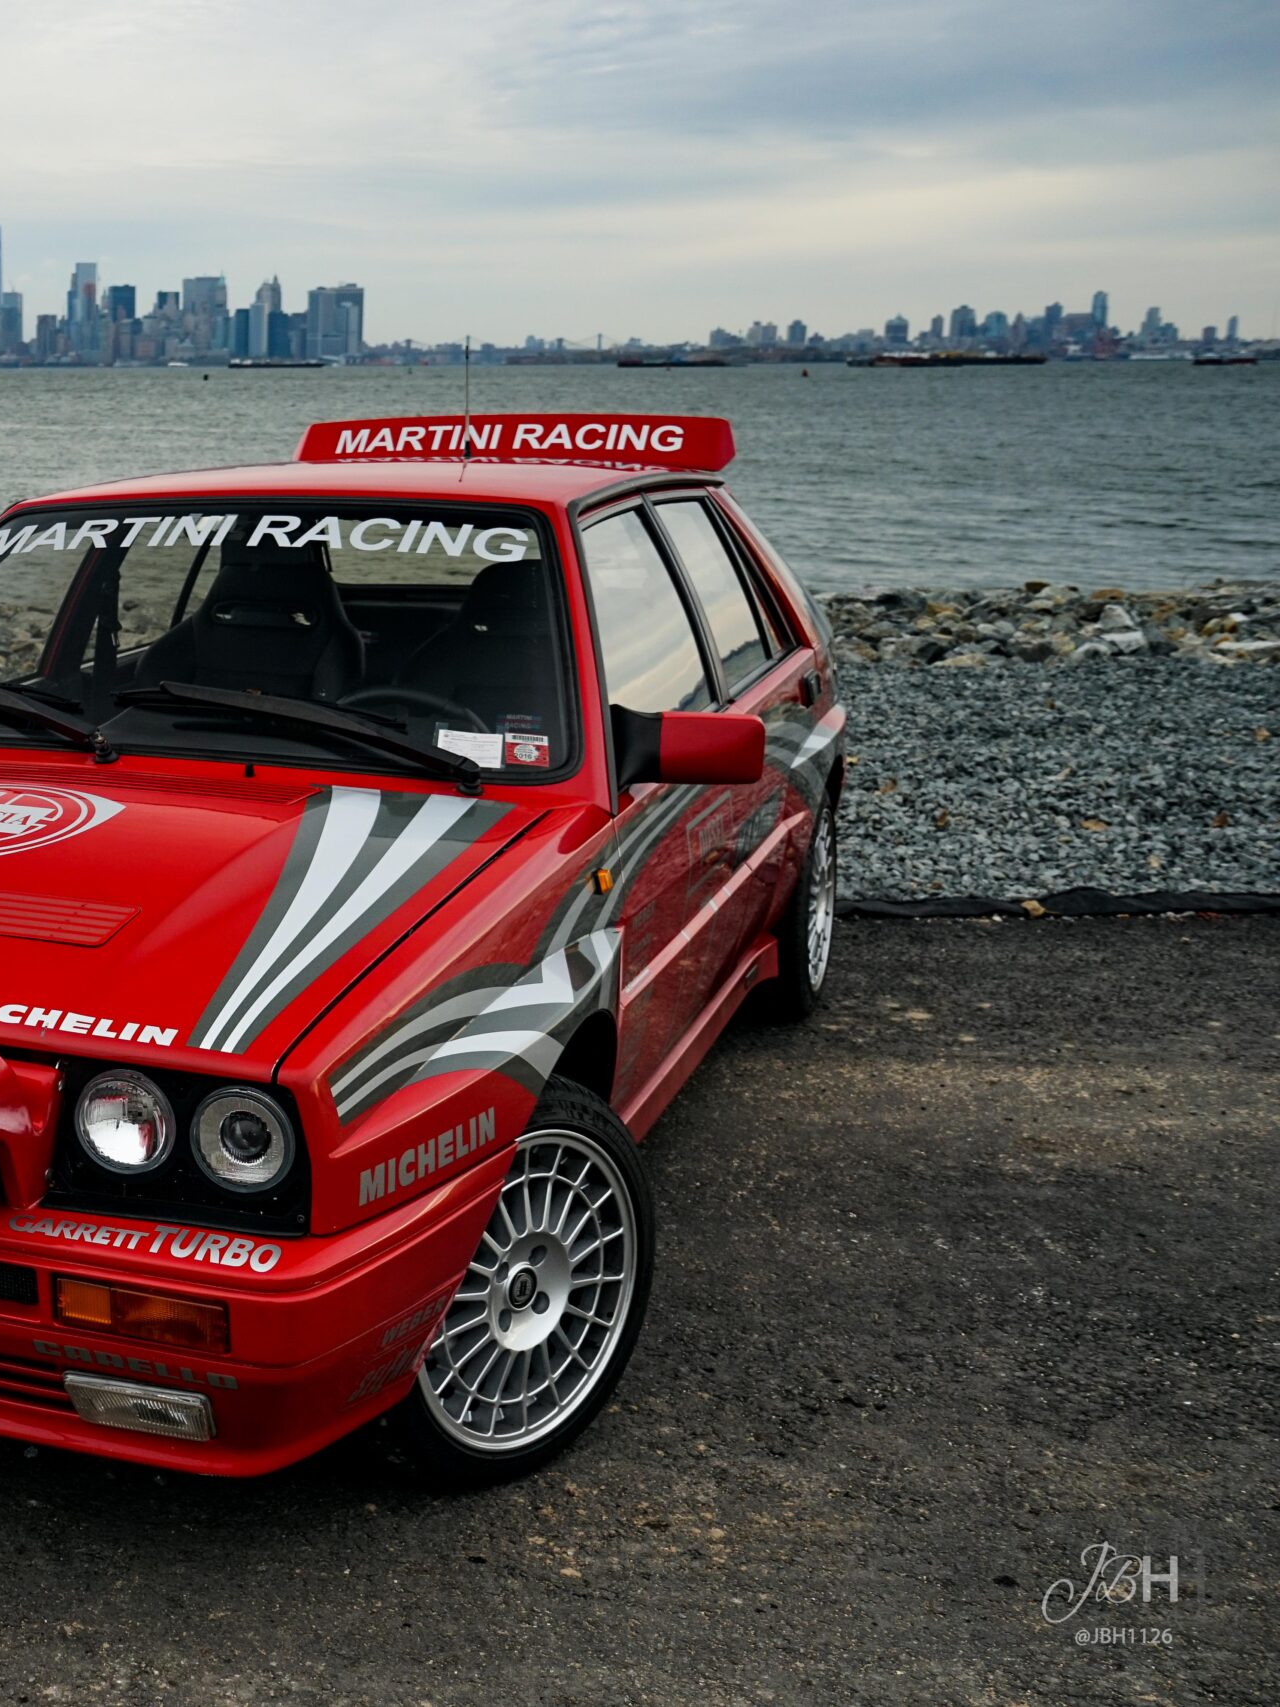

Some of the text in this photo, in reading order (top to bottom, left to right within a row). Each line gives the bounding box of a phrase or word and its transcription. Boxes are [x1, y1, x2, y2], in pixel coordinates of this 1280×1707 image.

[335, 423, 685, 454] MARTINI RACING
[246, 514, 530, 563] RACING
[358, 1106, 496, 1207] MICHELIN
[8, 1214, 283, 1273] GARRETT TURBO
[32, 1339, 239, 1391] CARELLO
